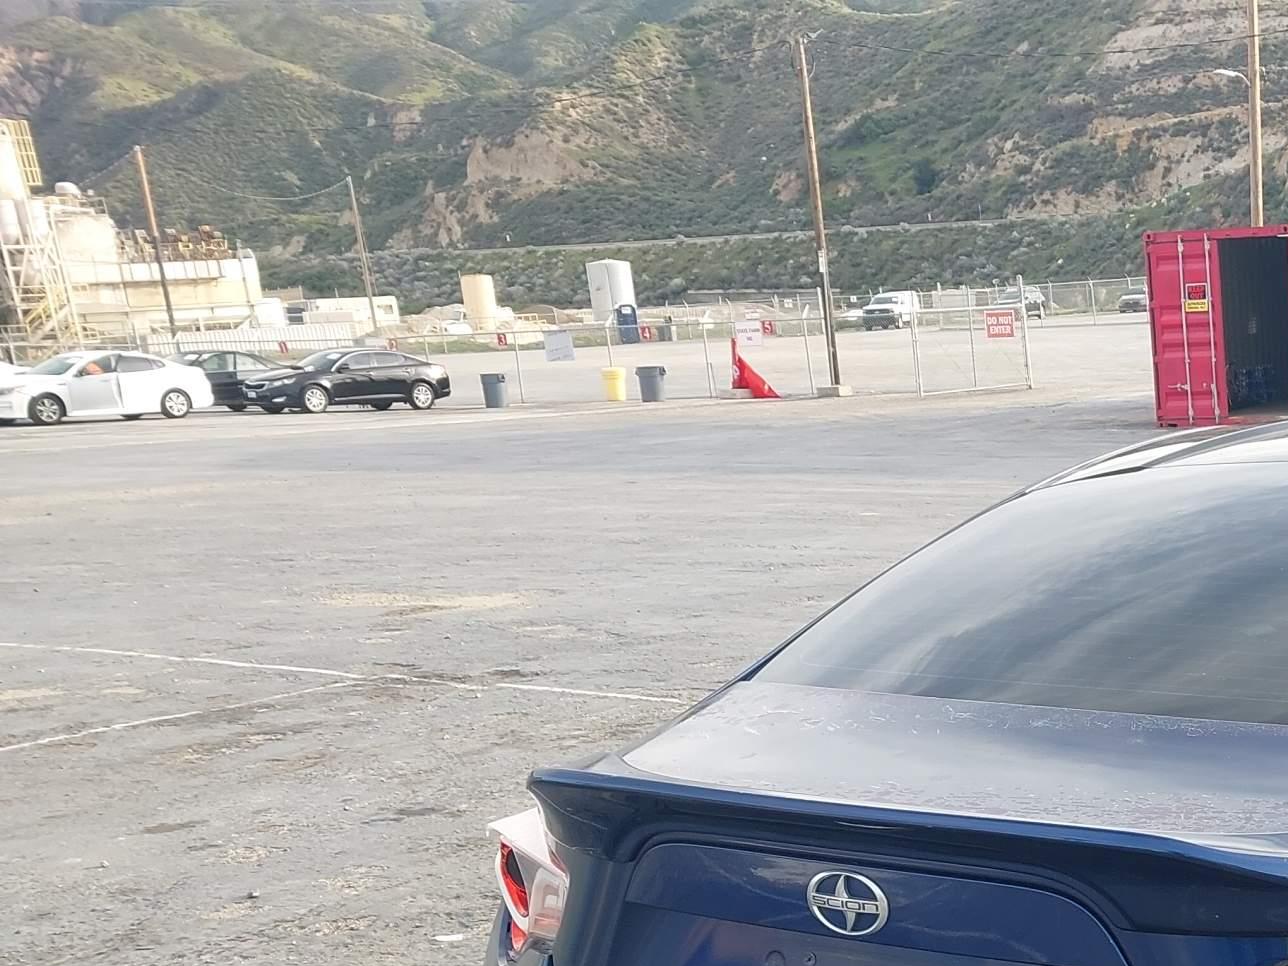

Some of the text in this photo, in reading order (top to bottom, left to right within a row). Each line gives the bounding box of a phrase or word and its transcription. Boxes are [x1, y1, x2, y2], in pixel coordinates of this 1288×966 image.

[987, 316, 1012, 325] DO NOT
[763, 320, 772, 333] 5
[990, 325, 1012, 334] ENTER
[812, 894, 880, 912] SCION
